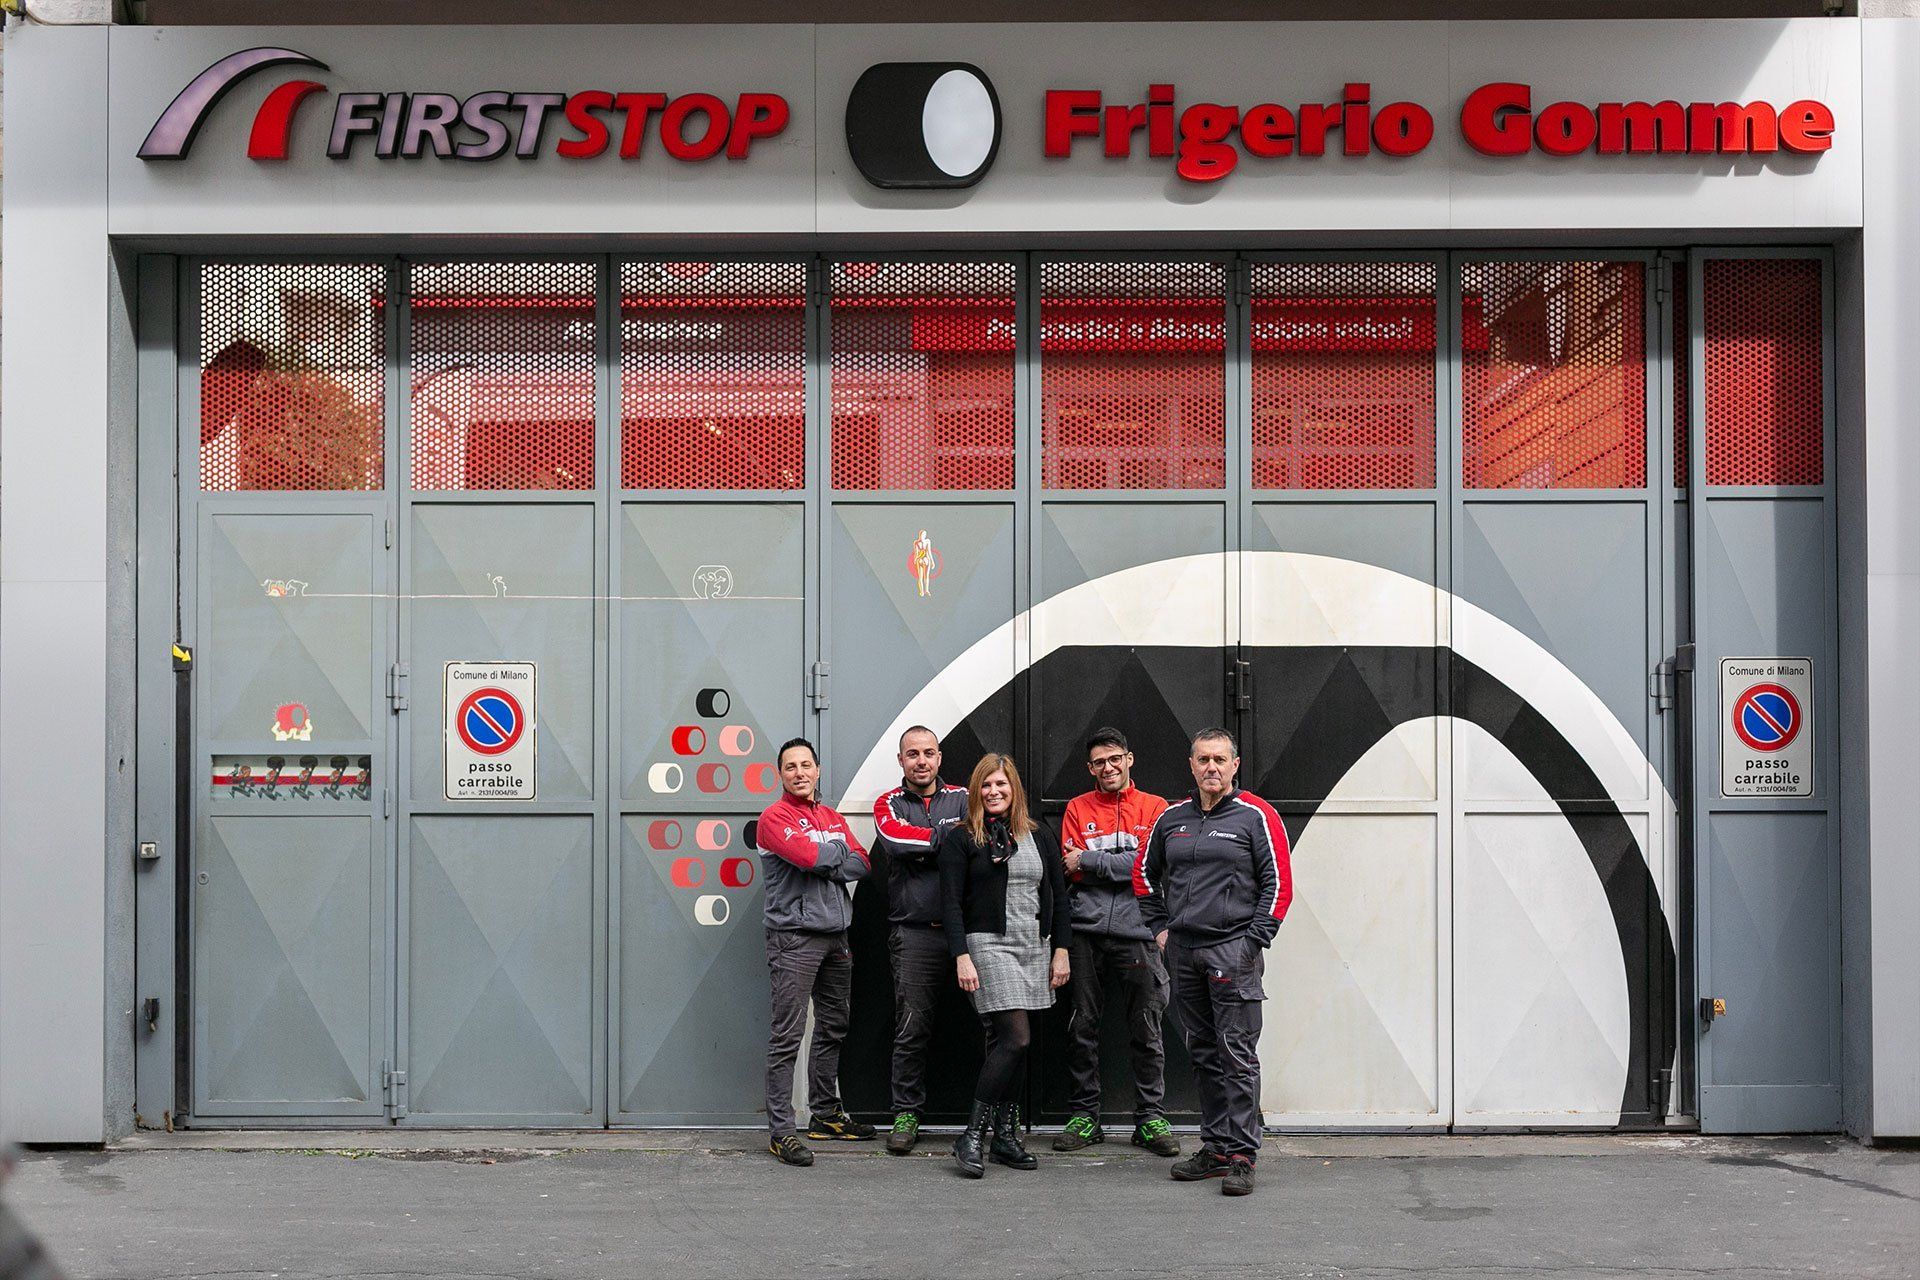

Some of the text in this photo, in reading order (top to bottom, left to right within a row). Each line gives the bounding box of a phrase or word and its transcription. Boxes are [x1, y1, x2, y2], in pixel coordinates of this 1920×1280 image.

[326, 90, 790, 161] FIRSTSTOP
[1044, 82, 1836, 183] Frigerio Gomme
[453, 670, 528, 680] Comune di Milano
[1729, 665, 1804, 676] Comune di Milano
[469, 763, 512, 773] passo
[1745, 759, 1789, 770] passo
[458, 776, 523, 788] carrabile
[1734, 772, 1800, 784] carrabile
